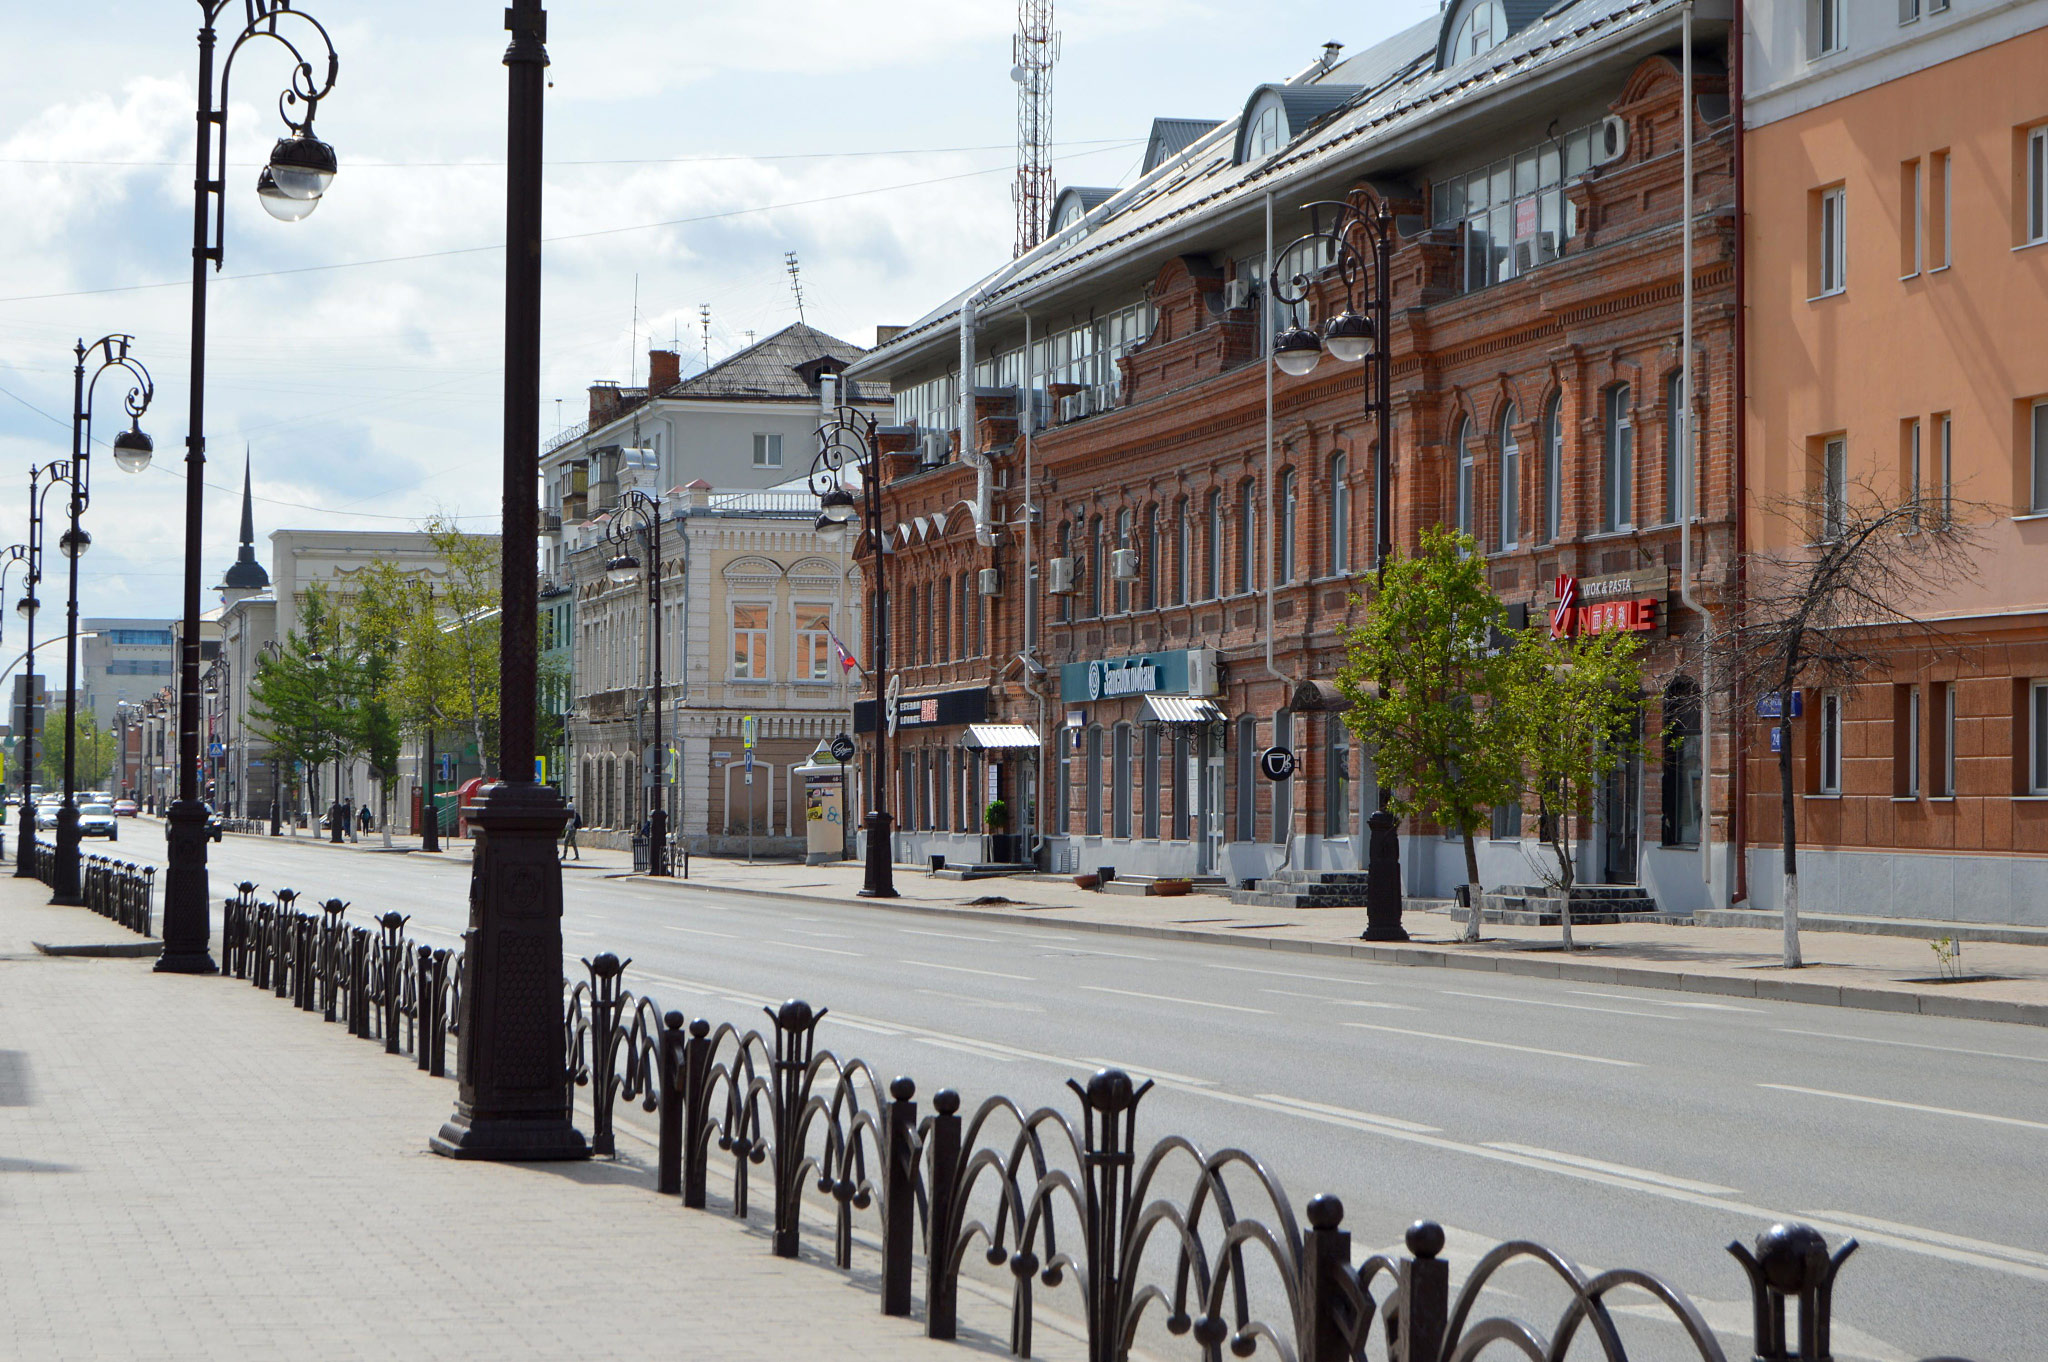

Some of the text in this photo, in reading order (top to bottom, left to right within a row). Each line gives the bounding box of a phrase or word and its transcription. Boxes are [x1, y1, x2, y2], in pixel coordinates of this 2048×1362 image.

[1583, 582, 1601, 596] WOK
[1609, 579, 1631, 594] PASTA
[1104, 657, 1156, 695] Запсибкомбанк
